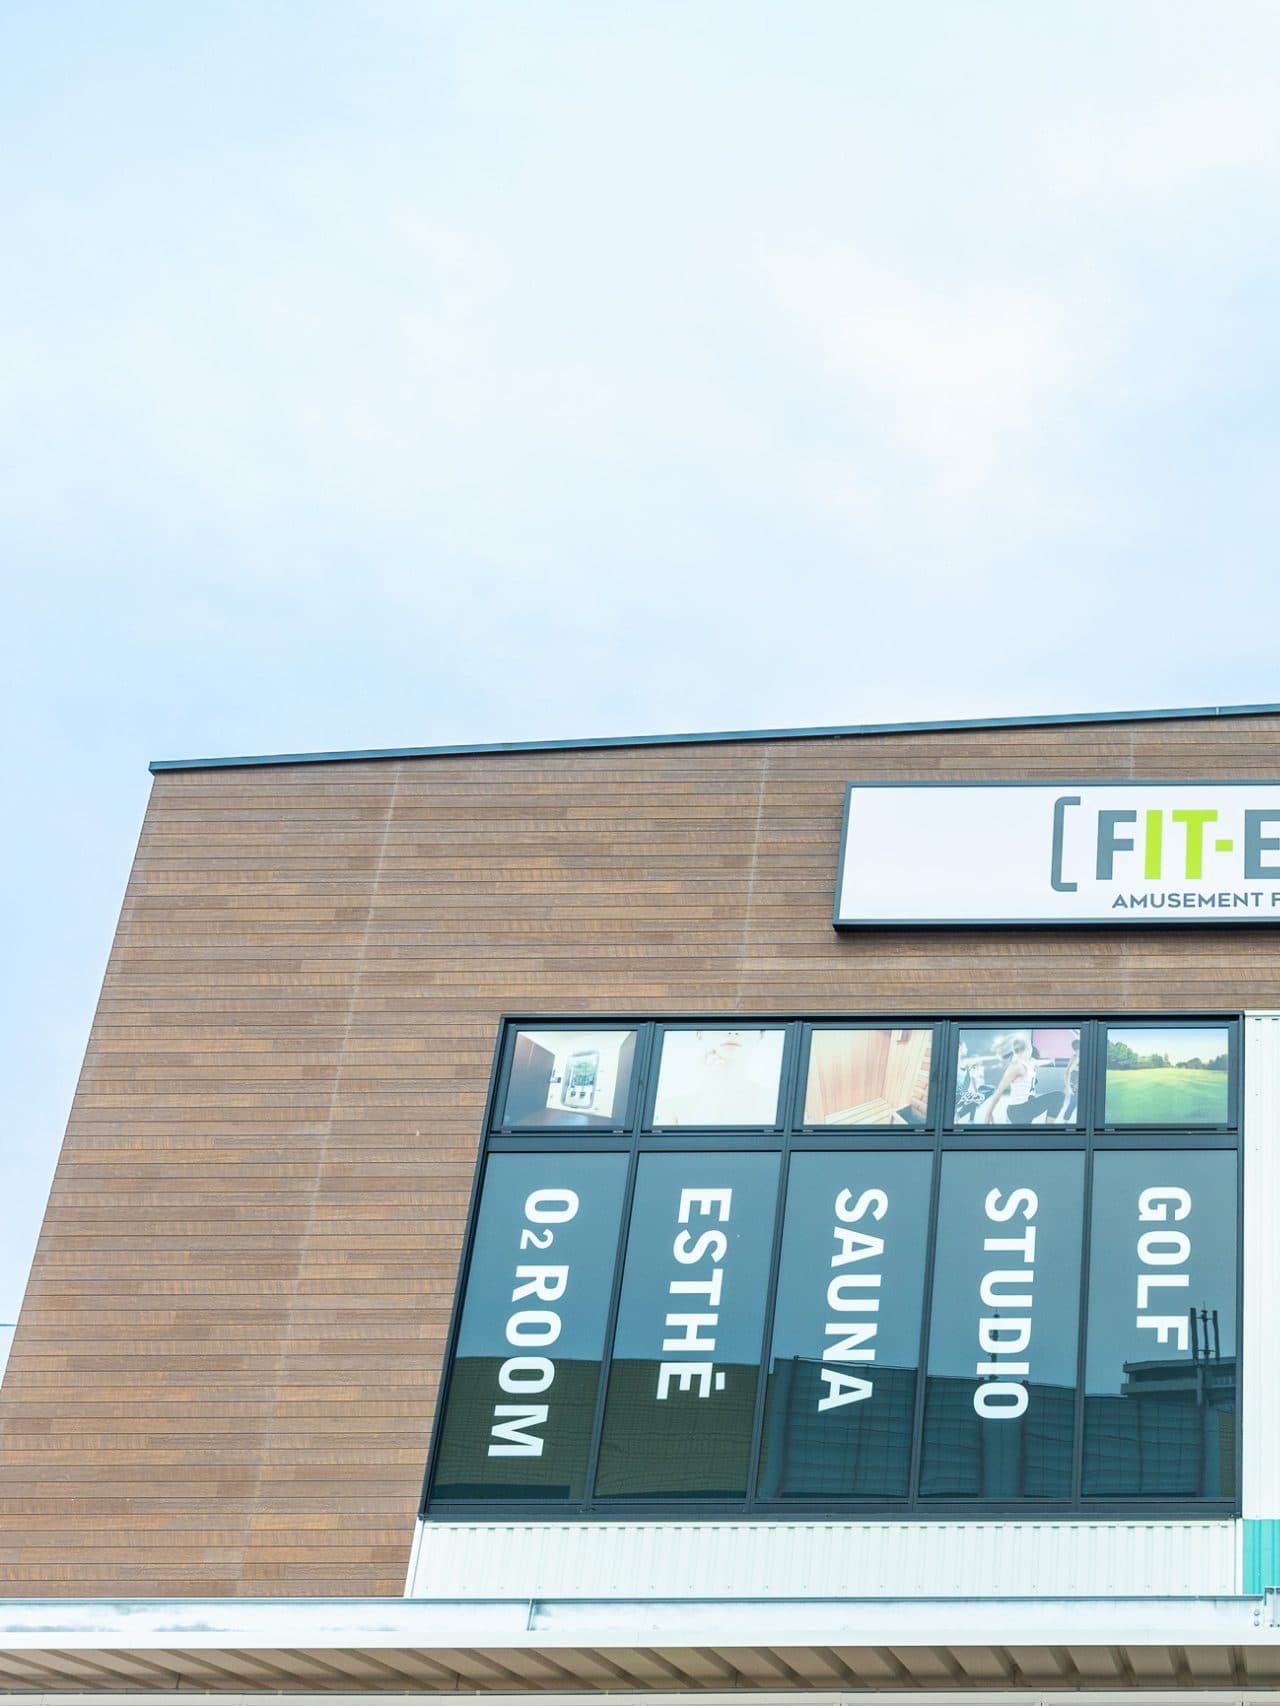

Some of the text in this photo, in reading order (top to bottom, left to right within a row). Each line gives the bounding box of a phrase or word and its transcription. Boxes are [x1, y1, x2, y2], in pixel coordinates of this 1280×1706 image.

[1111, 891, 1265, 909] AMUSEMENT
[487, 1265, 570, 1457] ROOM
[818, 1188, 889, 1412] SAUNA
[973, 1187, 1039, 1419] STUDIO
[1136, 1186, 1192, 1351] GOLF
